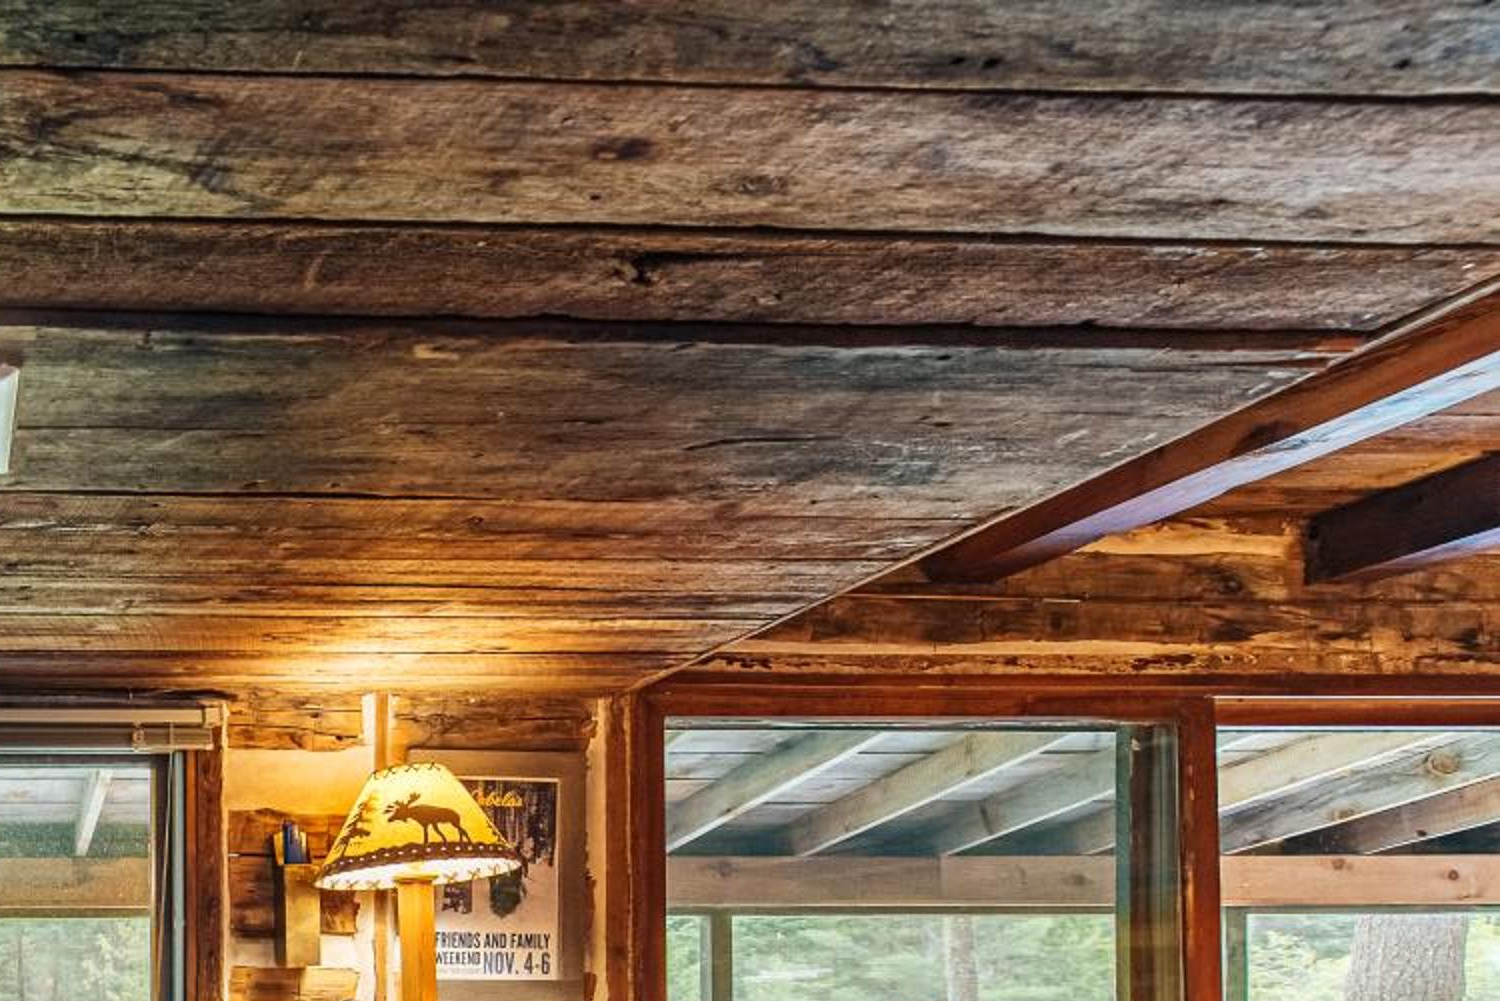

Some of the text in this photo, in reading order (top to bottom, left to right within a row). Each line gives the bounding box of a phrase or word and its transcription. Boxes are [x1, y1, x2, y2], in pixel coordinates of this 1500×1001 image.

[436, 932, 551, 950] FRIENDS AND FAMILY
[436, 952, 551, 975] WEEKEND NOV. 4-6
